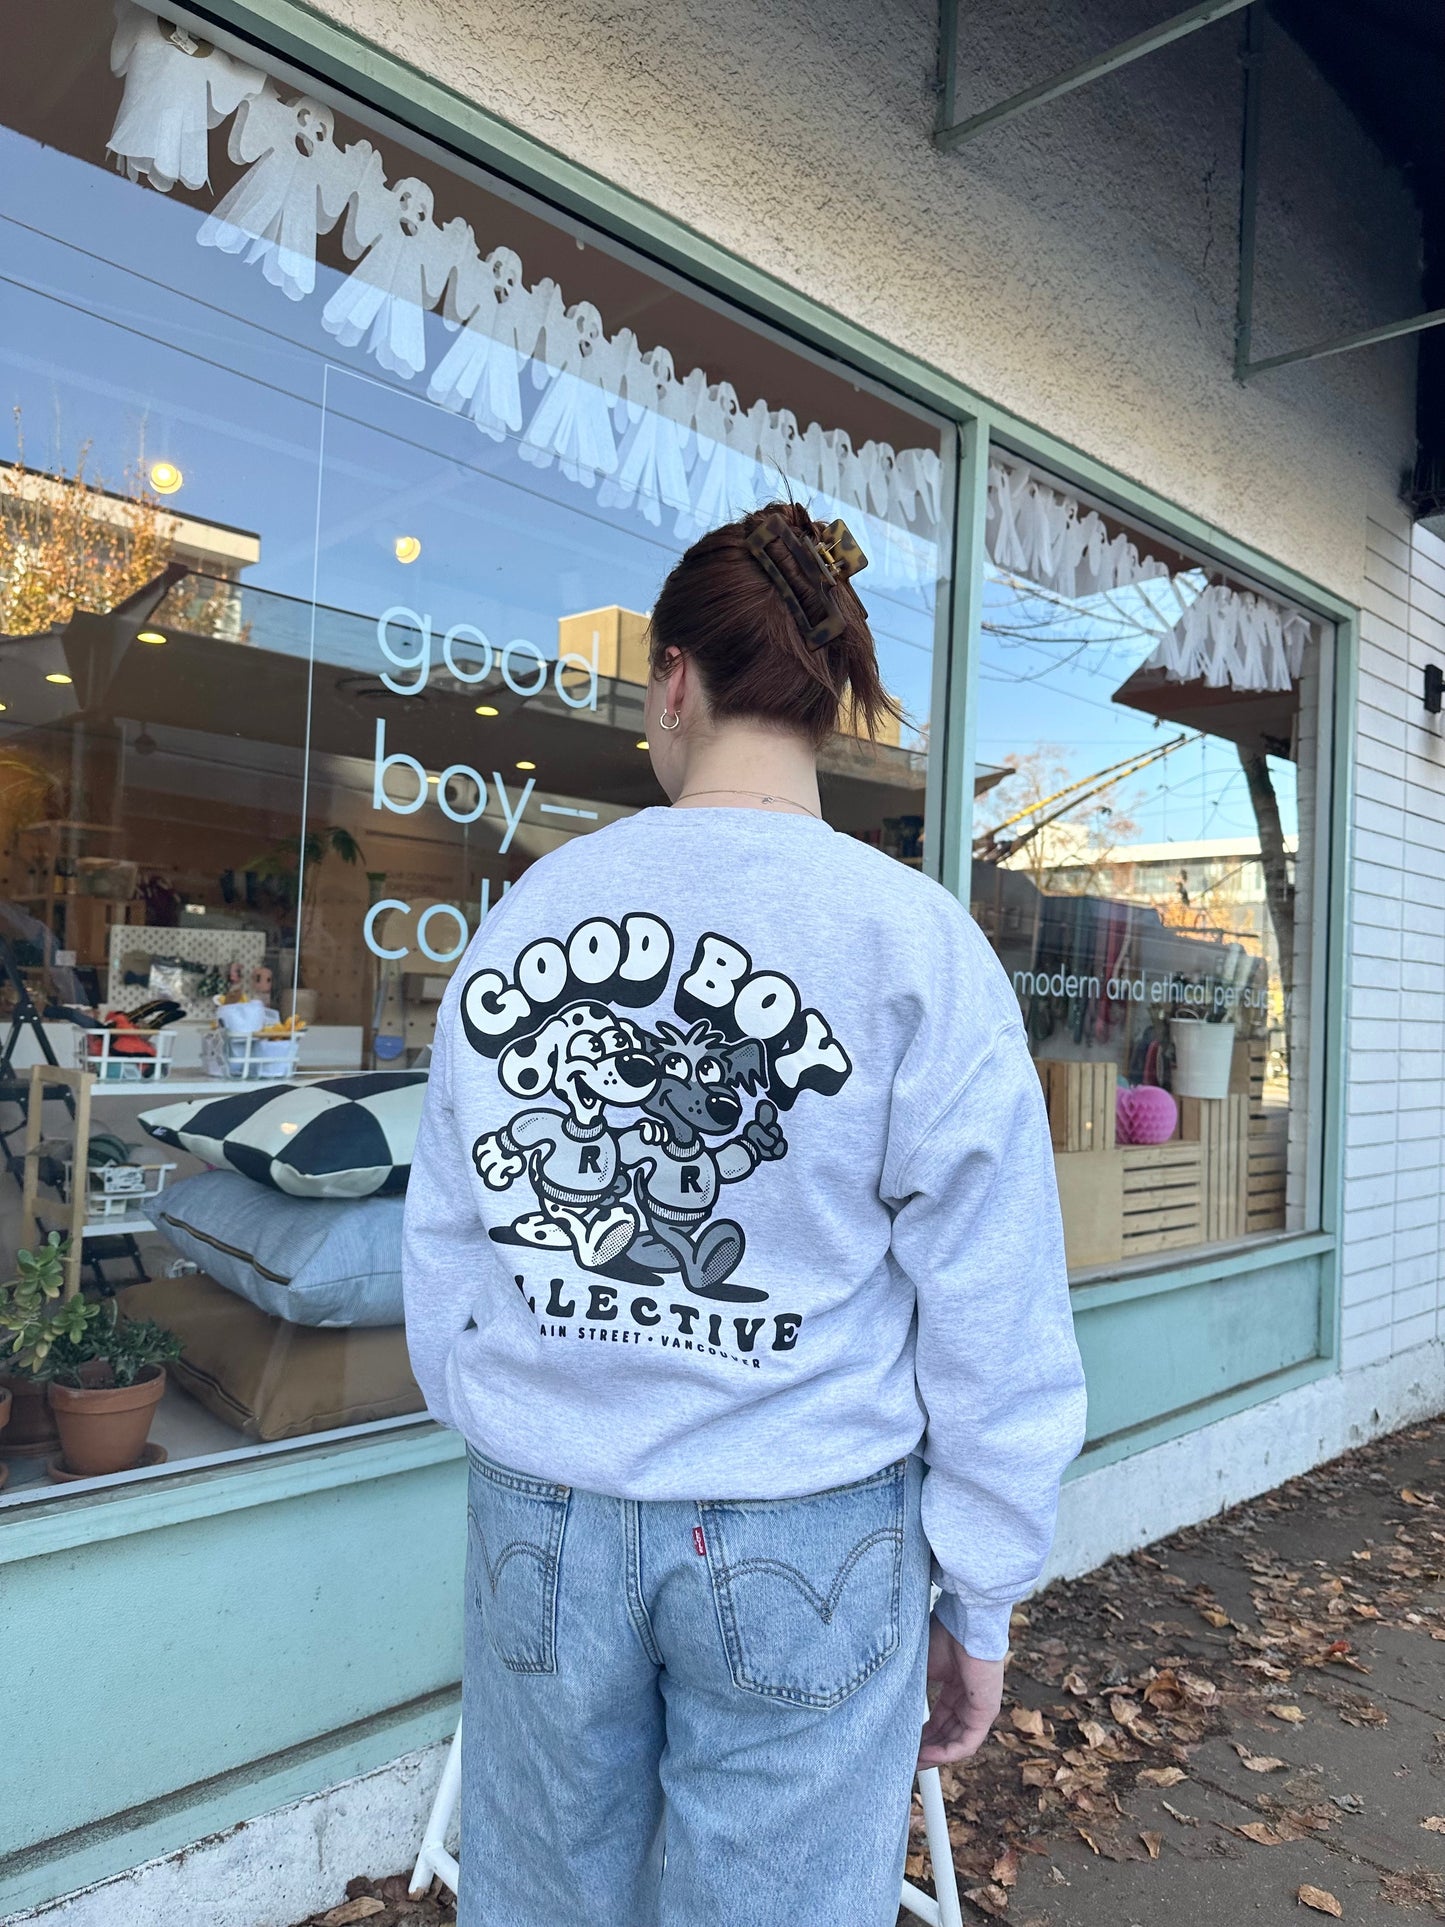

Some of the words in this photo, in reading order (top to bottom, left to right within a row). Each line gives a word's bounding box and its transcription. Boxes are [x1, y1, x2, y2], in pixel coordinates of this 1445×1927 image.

[377, 606, 599, 711] good
[364, 879, 511, 963] co
[1013, 963, 1101, 1000] modern
[1107, 970, 1145, 1001] and
[1150, 974, 1210, 1006] ethical
[461, 912, 674, 1058] GOOD
[674, 931, 853, 1110] BOY
[578, 1145, 602, 1174] R
[680, 1165, 702, 1194] R
[578, 1327, 641, 1344] STREET
